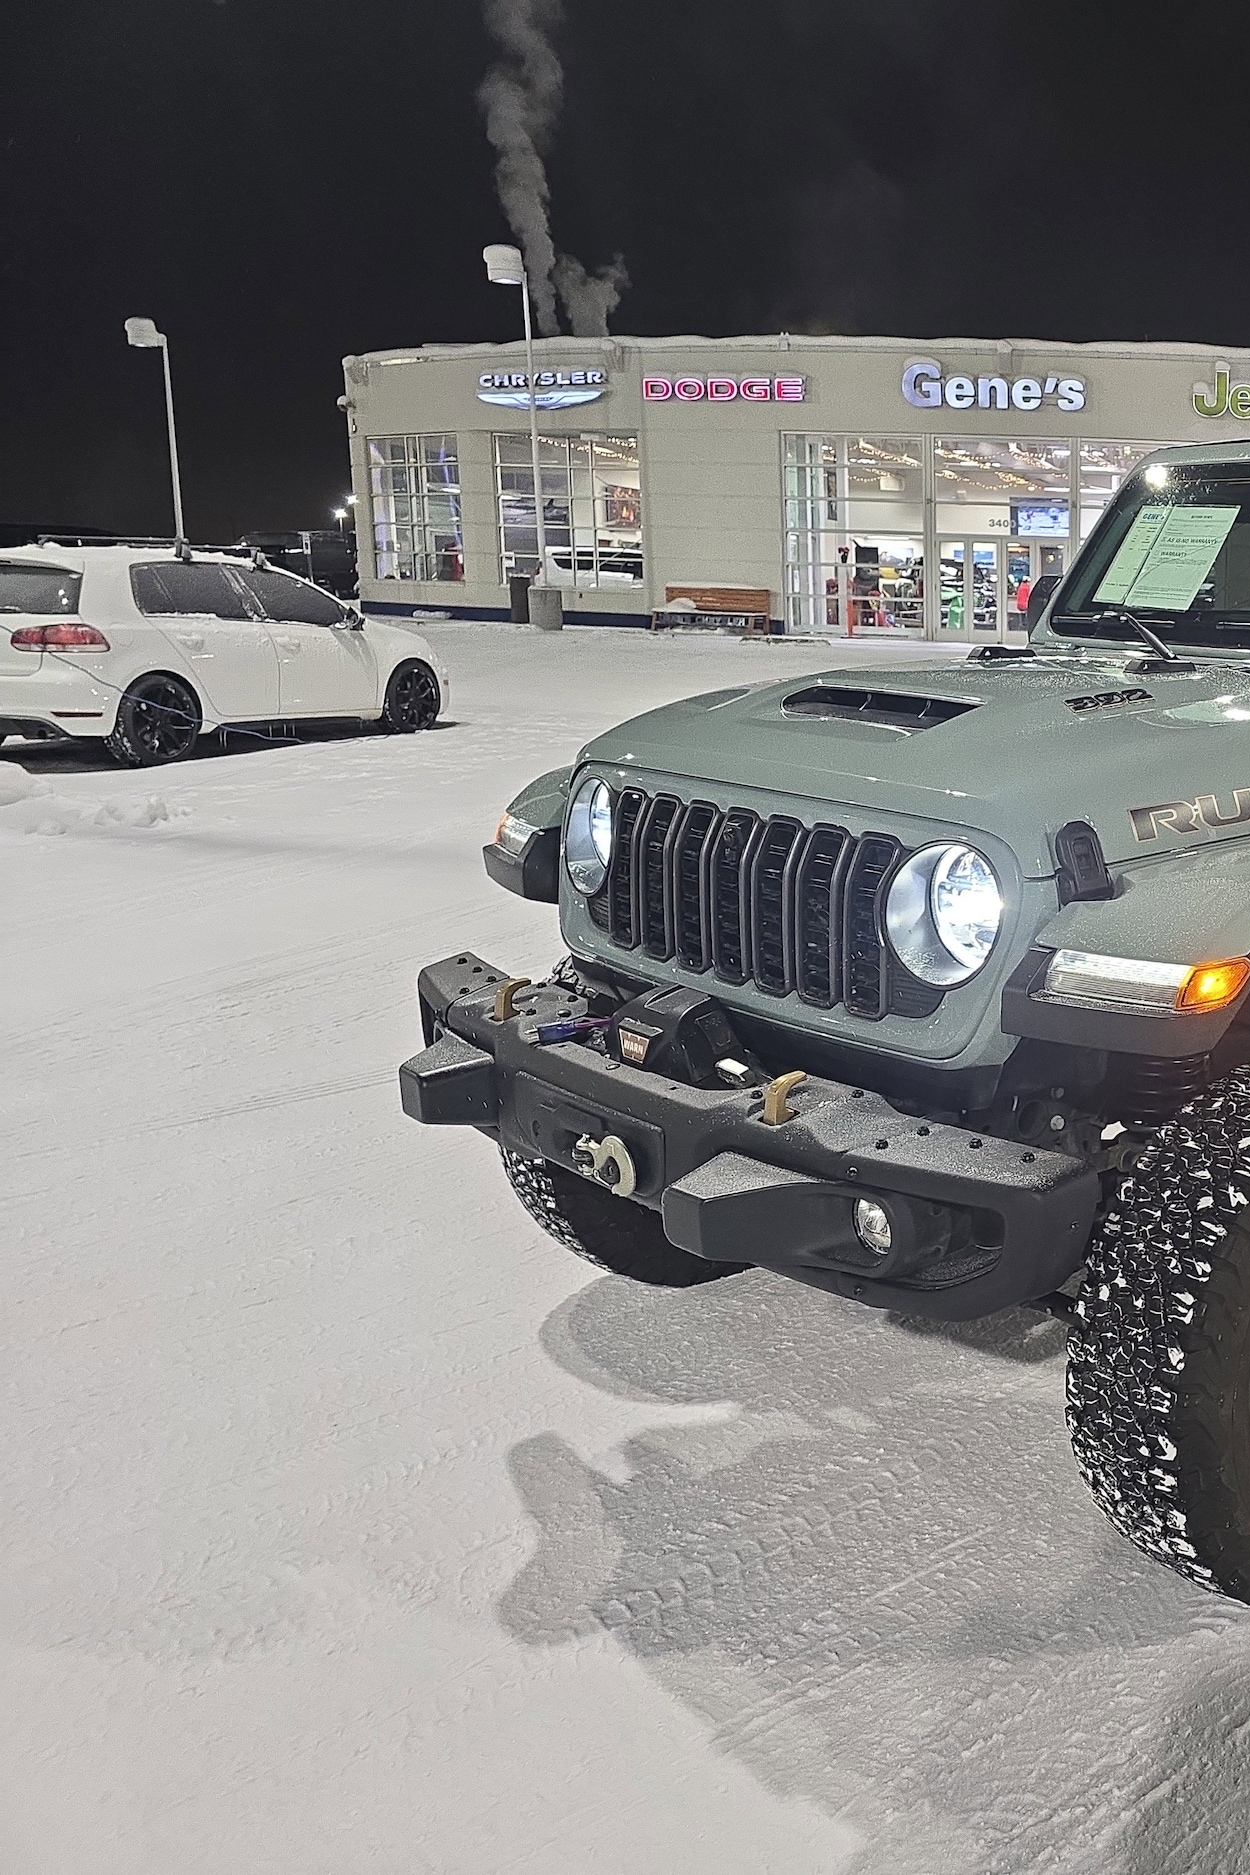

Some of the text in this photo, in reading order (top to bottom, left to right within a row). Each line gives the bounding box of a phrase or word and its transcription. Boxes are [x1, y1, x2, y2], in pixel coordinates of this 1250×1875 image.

[479, 370, 602, 388] CHRYSLER
[642, 377, 804, 401] DODGE
[901, 362, 1086, 412] Gene's
[623, 1038, 644, 1055] WARN
